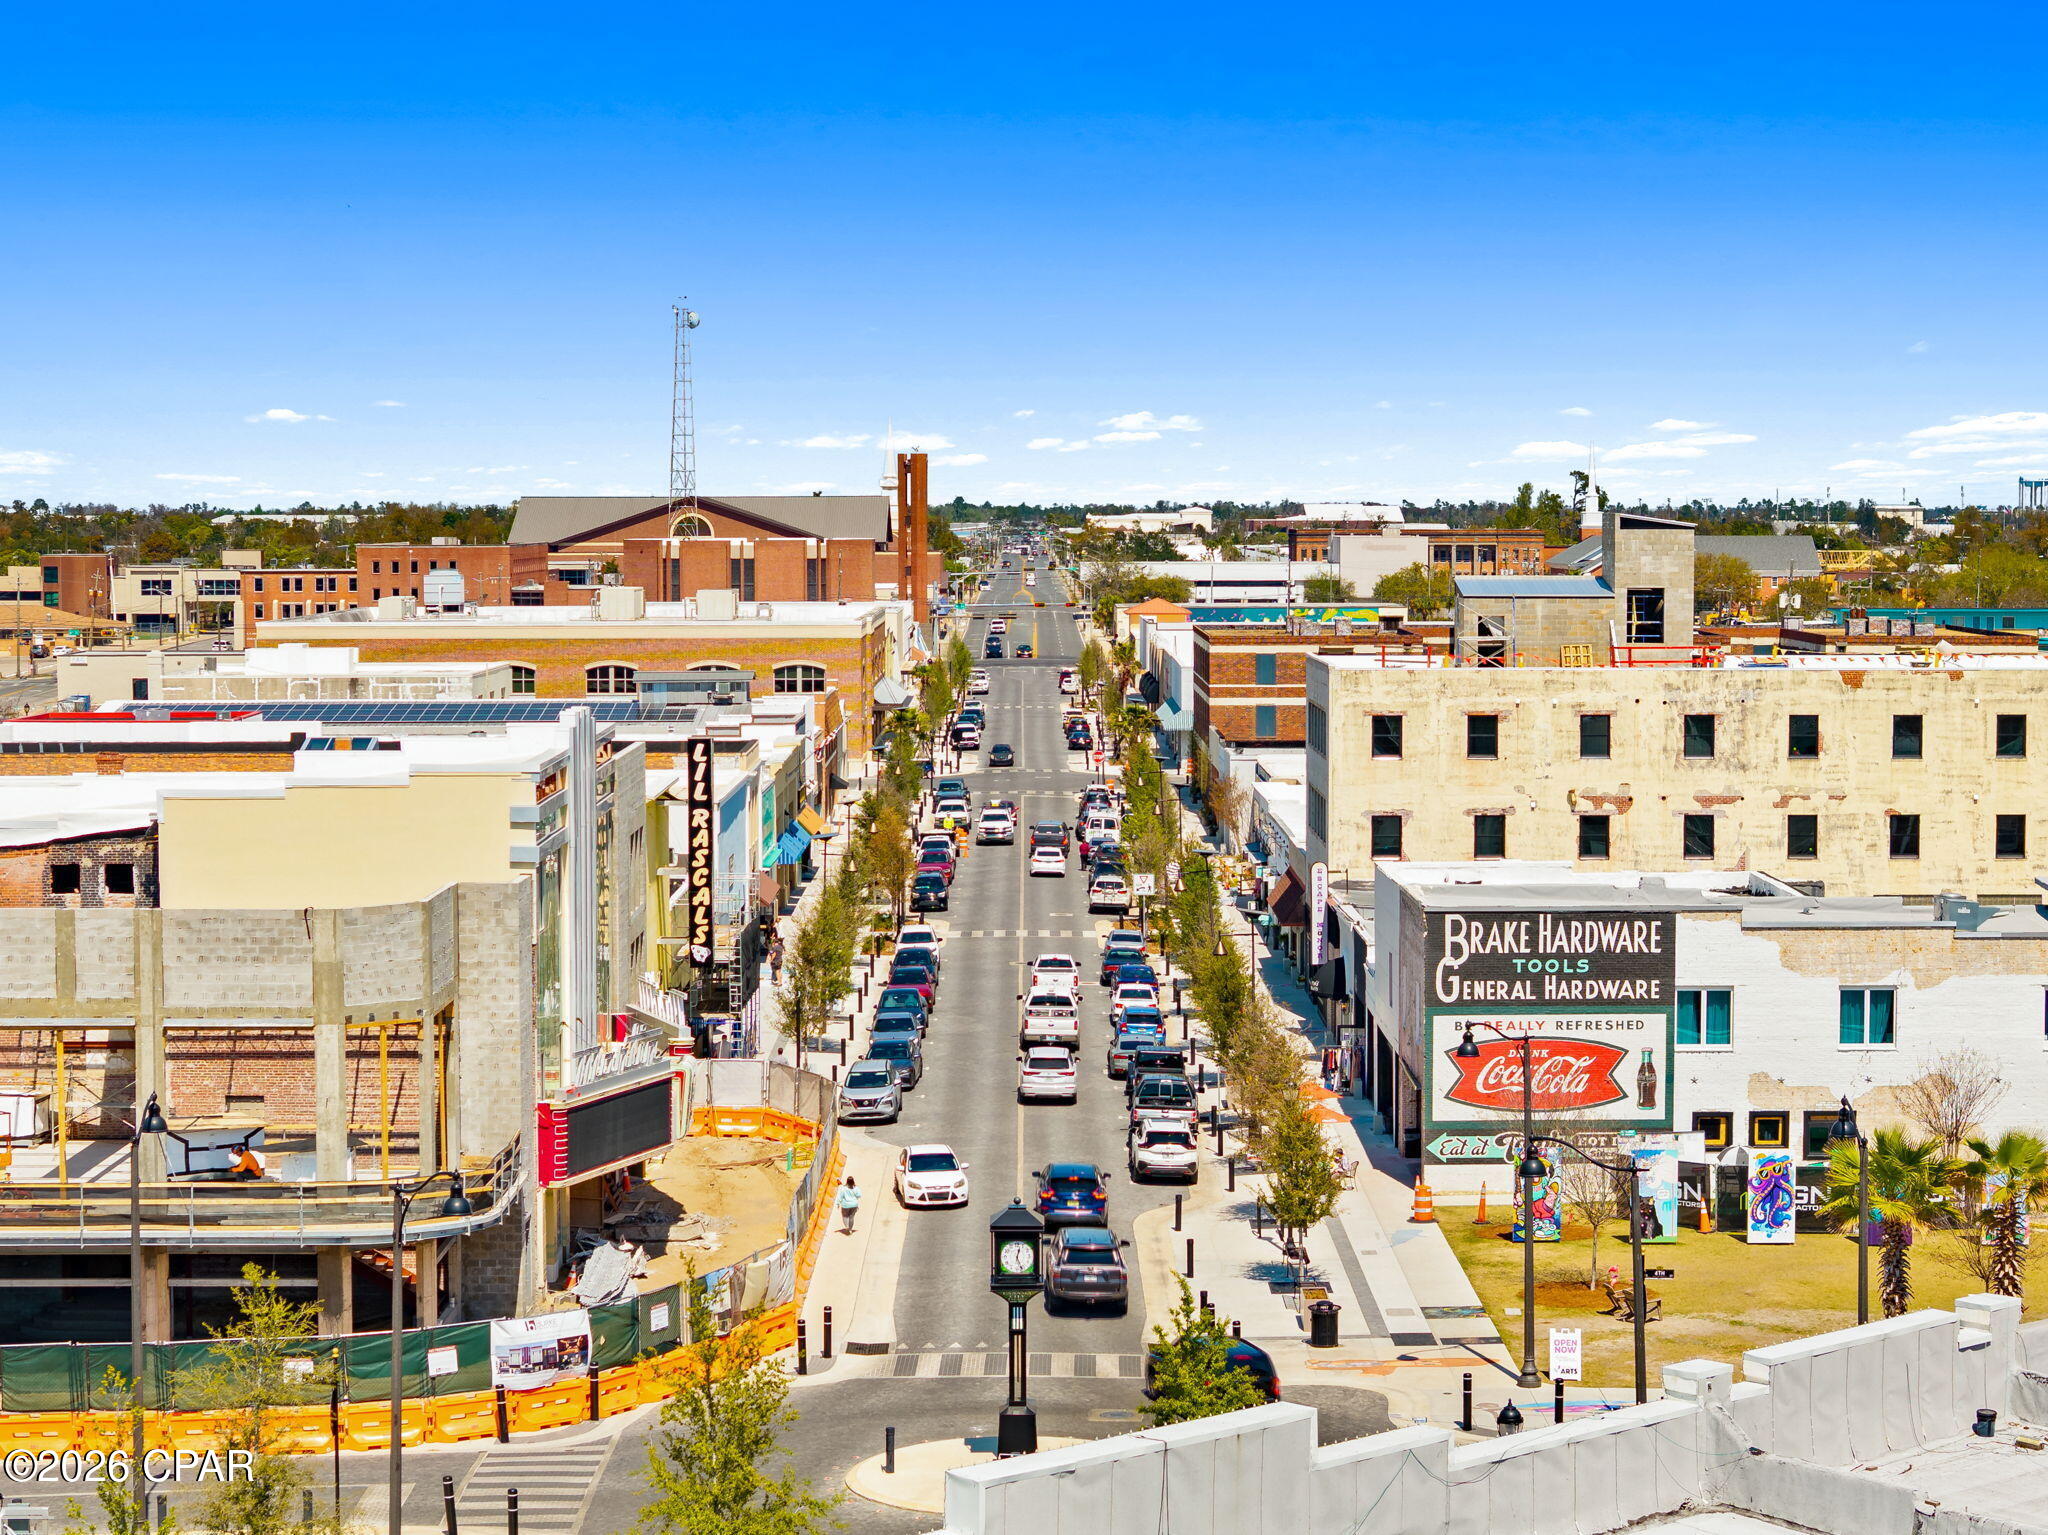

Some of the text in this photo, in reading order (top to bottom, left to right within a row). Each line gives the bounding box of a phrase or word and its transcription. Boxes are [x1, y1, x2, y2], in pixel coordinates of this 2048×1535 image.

[691, 743, 711, 945] LIL RASCALS
[1444, 913, 1662, 966] BRAKE HARDWARE
[1512, 958, 1590, 973] TOOLS
[1435, 956, 1661, 1003] GENERAL HARDWARE
[1484, 1020, 1545, 1031] REALLY
[1555, 1020, 1645, 1031] REFRESHED
[1507, 1049, 1550, 1058] DRNK
[1440, 1137, 1467, 1157] Eat
[1471, 1136, 1489, 1156] at
